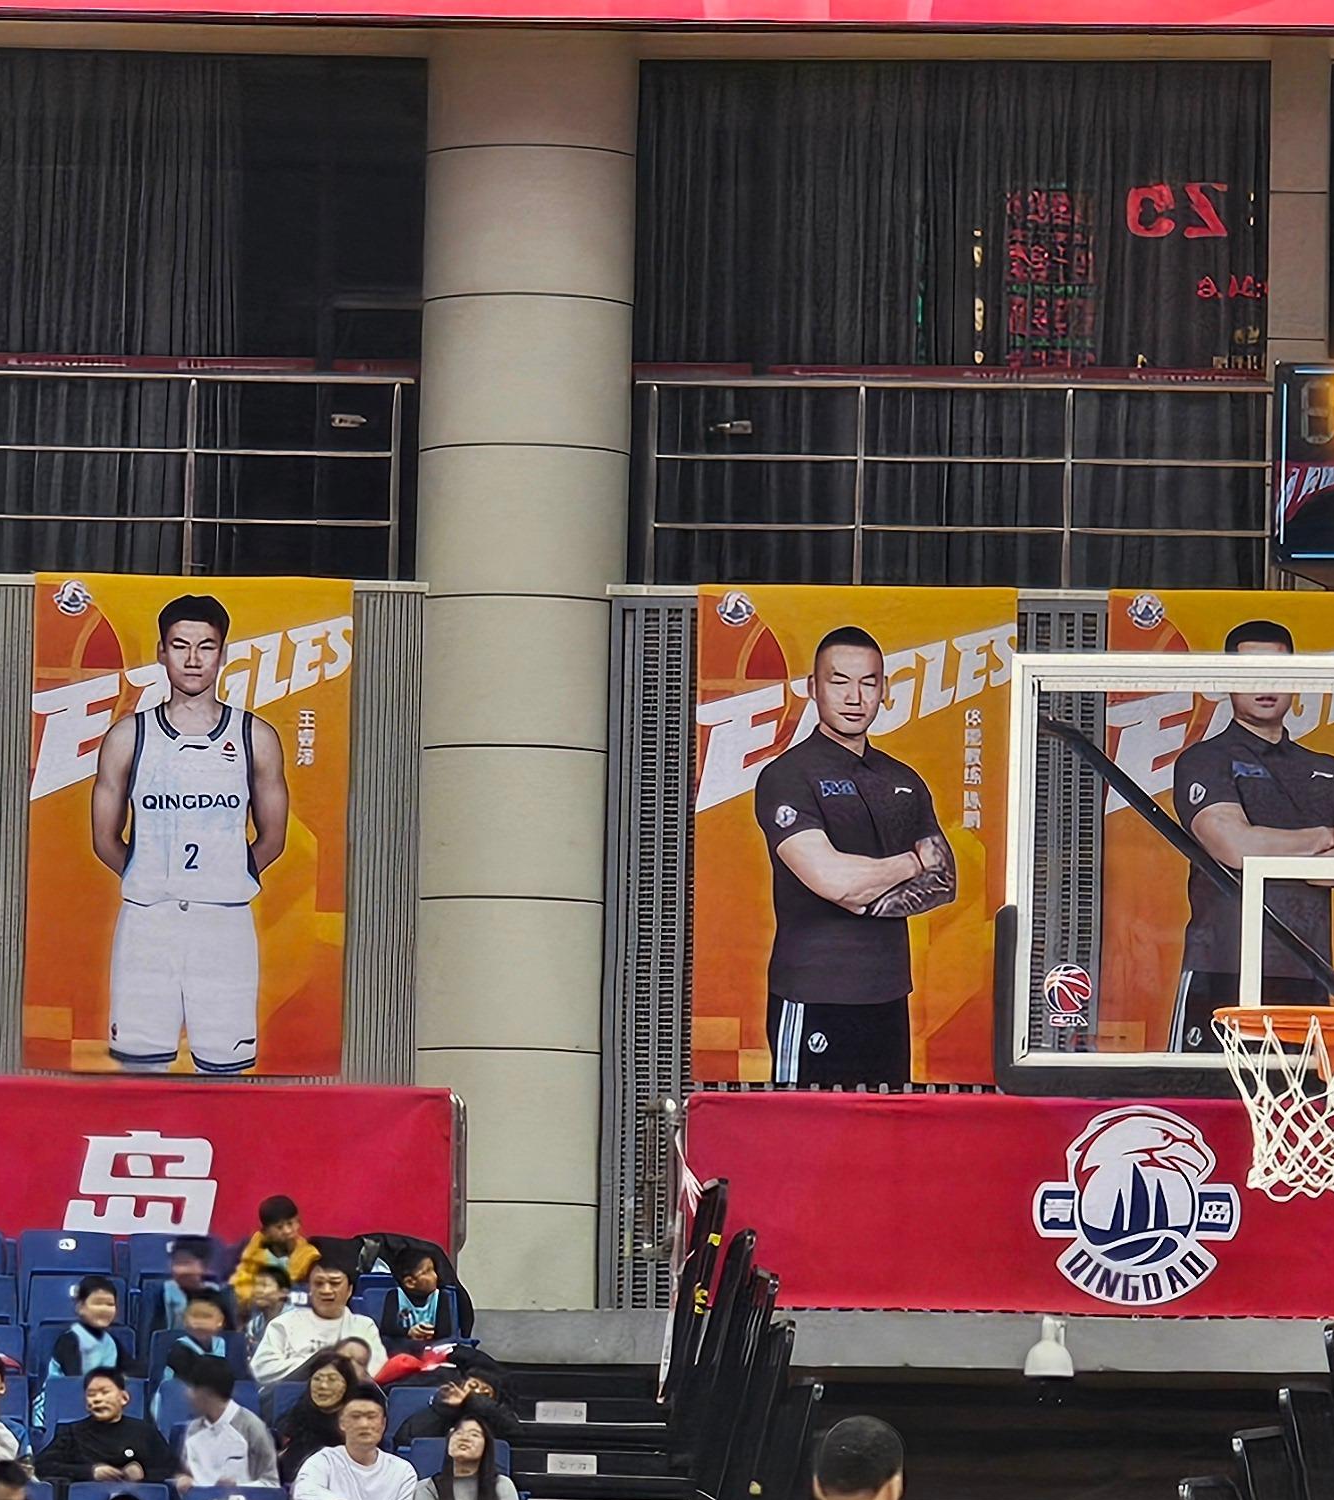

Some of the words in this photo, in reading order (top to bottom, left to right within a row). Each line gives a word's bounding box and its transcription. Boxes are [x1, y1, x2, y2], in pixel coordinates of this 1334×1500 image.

[142, 794, 240, 810] QINGDAO
[184, 843, 199, 870] 2
[1066, 1250, 1210, 1301] QINGDAO
